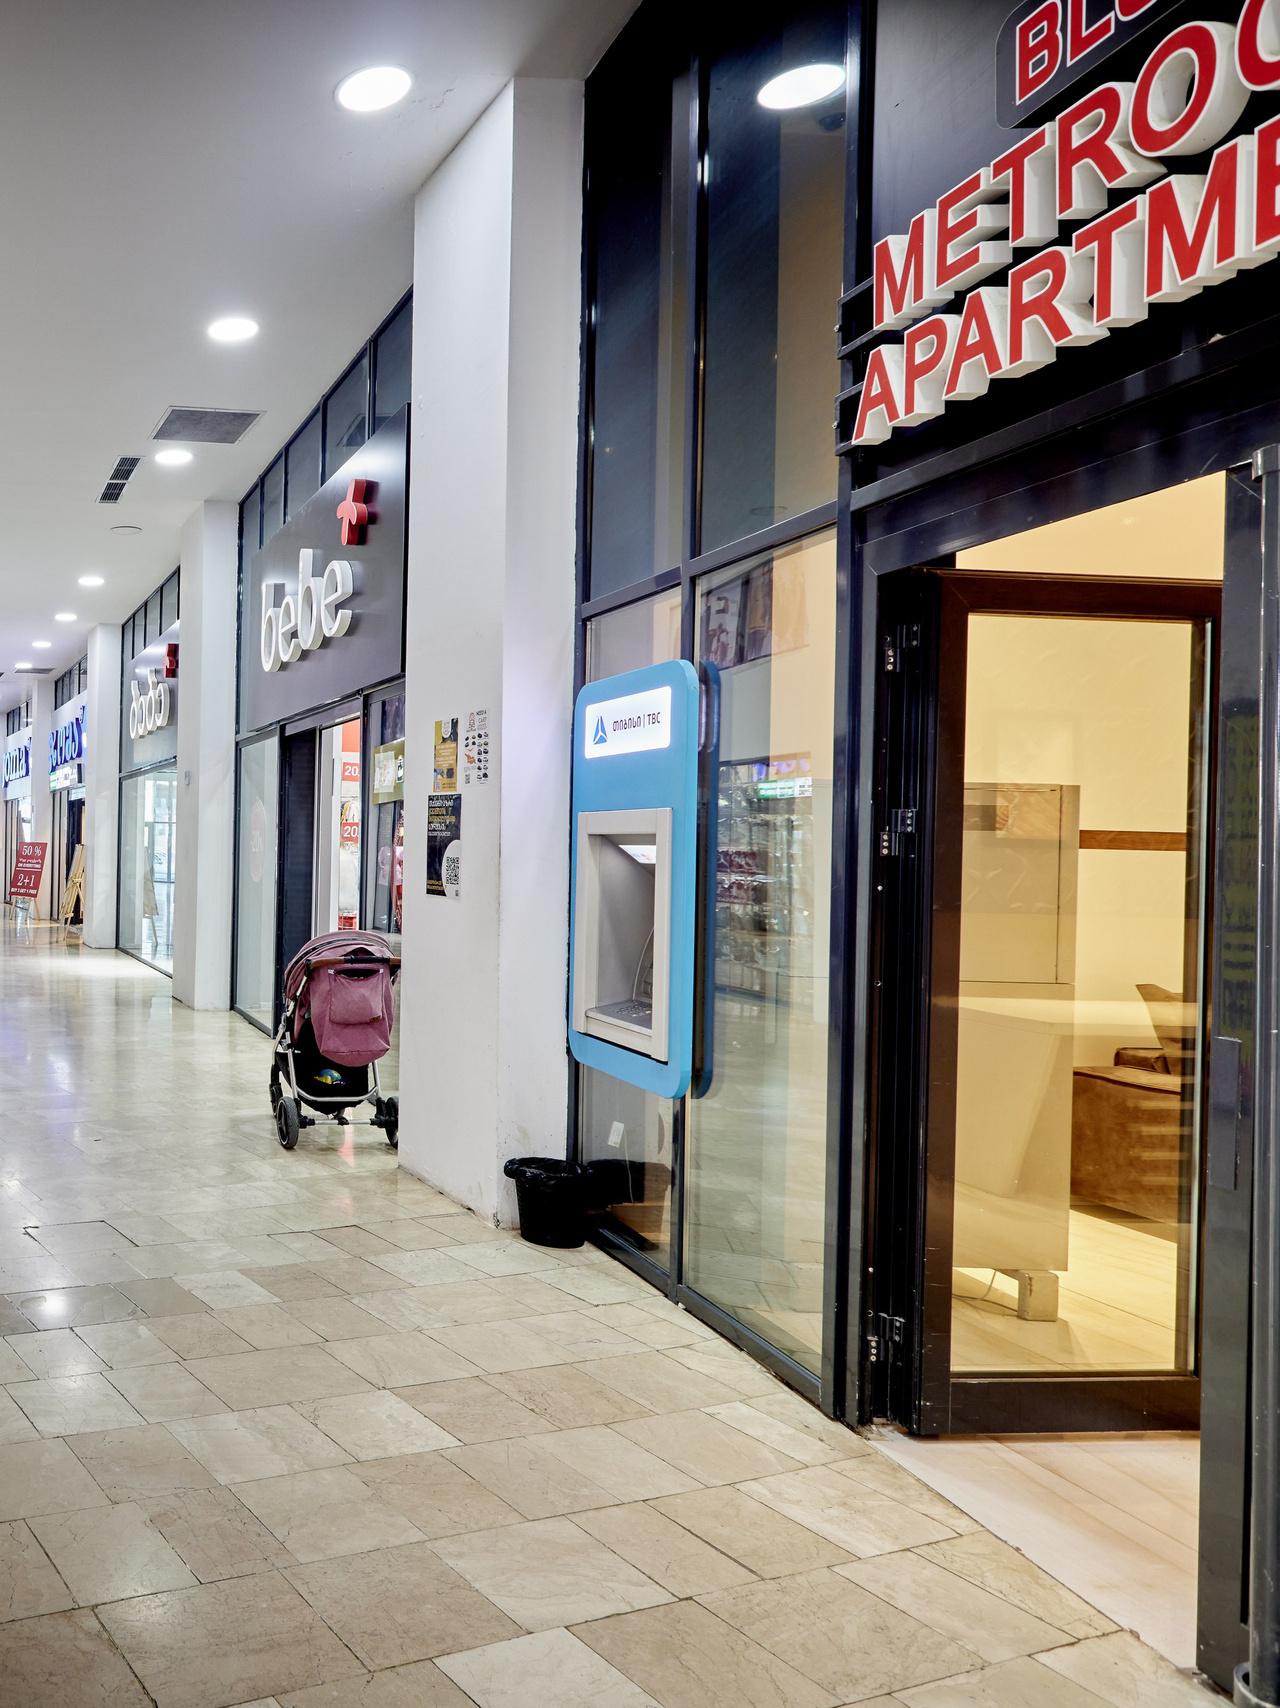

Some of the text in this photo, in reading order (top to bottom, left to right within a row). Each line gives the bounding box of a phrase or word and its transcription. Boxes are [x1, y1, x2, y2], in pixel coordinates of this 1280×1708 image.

[261, 548, 353, 672] bebe
[612, 711, 661, 732] თიბისი TBC
[344, 765, 360, 776] 20
[343, 825, 359, 837] 20
[22, 845, 42, 856] 50 %
[17, 873, 35, 887] 2+1
